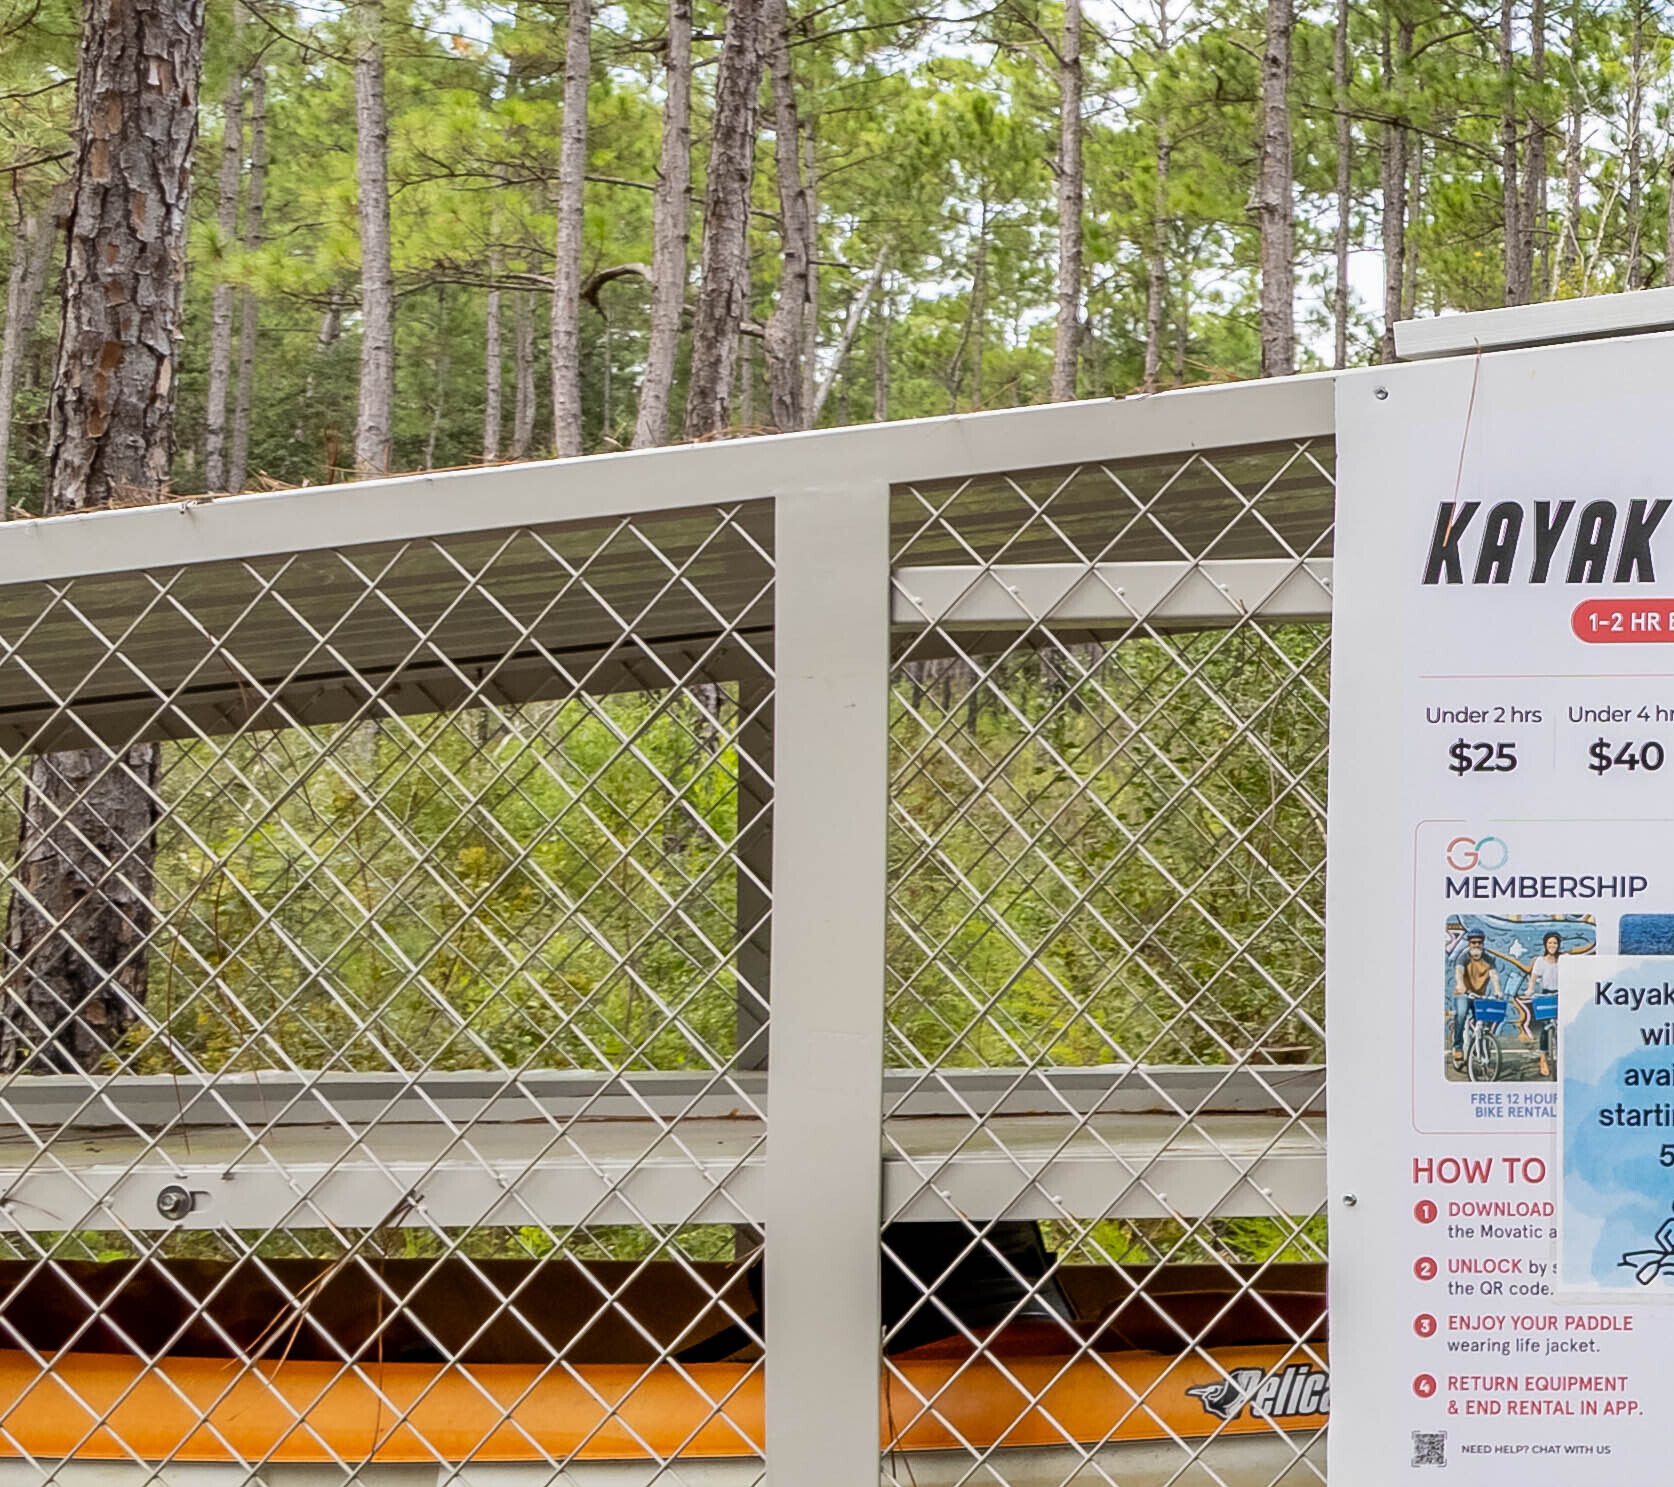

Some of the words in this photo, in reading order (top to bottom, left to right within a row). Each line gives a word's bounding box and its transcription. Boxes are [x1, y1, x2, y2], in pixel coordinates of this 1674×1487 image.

[1421, 499, 1672, 585] KAYAK
[1589, 612, 1624, 632] 1-2
[1630, 612, 1662, 632] HR
[1426, 705, 1486, 724] Under
[1493, 707, 1505, 723] 2
[1511, 704, 1542, 723] hrs
[1568, 705, 1629, 723] Under
[1636, 705, 1650, 723] 4
[1448, 739, 1518, 775] $25
[1588, 738, 1664, 774] $40
[1445, 876, 1647, 899] MEMBERSHIP
[1471, 1094, 1501, 1104] FREE
[1508, 1094, 1519, 1104] 12
[1476, 1107, 1503, 1117] BIKE
[1412, 1158, 1493, 1184] HOW
[1502, 1158, 1546, 1184] TO
[1449, 1202, 1555, 1217] DOWNLOAD
[1448, 1225, 1474, 1238] the
[1481, 1225, 1542, 1238] Movatic
[1449, 1259, 1522, 1273] UNLOCK
[1529, 1260, 1547, 1277] by
[1448, 1281, 1474, 1295] the
[1480, 1281, 1503, 1296] QR
[1510, 1281, 1554, 1296] code.
[1449, 1316, 1505, 1330] ENJOY
[1510, 1316, 1558, 1330] YOUR
[1565, 1316, 1633, 1331] PADDLE
[1448, 1339, 1510, 1355] wearing
[1516, 1338, 1540, 1352] life
[1546, 1339, 1600, 1355] jacket.
[1449, 1377, 1518, 1391] RETURN
[1525, 1377, 1628, 1391] EQUIPMENT
[1448, 1400, 1458, 1414] &
[1466, 1400, 1500, 1414] END
[1508, 1401, 1574, 1415] RENTAL
[1581, 1401, 1597, 1415] IN
[1604, 1401, 1643, 1415] APP.
[1461, 1445, 1491, 1454] NEED
[1495, 1445, 1529, 1454] HELP?
[1532, 1445, 1562, 1454] CHAT
[1565, 1445, 1593, 1454] WITH
[1596, 1445, 1611, 1454] US
